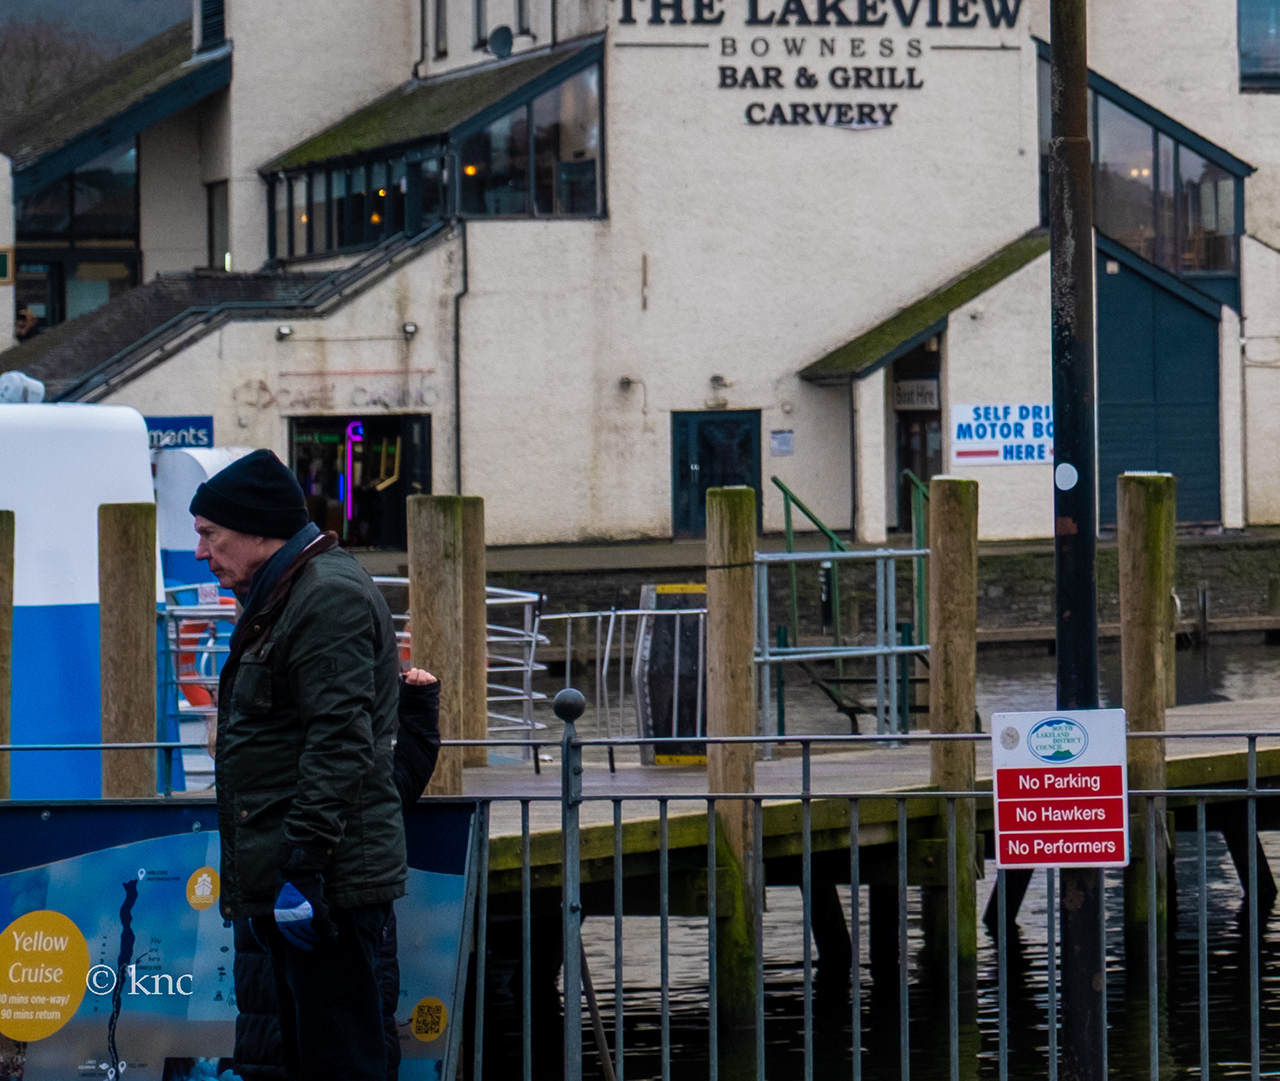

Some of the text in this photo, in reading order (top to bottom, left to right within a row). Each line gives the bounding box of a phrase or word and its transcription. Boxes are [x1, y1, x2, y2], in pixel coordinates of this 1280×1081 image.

[721, 38, 923, 57] BOWNESS
[718, 66, 924, 89] BAR & GRILL
[745, 103, 899, 125] CARVERY
[973, 406, 1010, 421] SELF
[956, 422, 1024, 440] MOTOR
[1003, 444, 1045, 460] HERE
[1019, 773, 1100, 791] No Parking
[1016, 806, 1106, 822] No Hawkers
[1008, 839, 1116, 855] No Performers
[13, 931, 69, 952] Yellow
[9, 962, 63, 983] Cruise
[9, 993, 29, 1004] mins
[1, 1009, 60, 1019] 90 mins return
